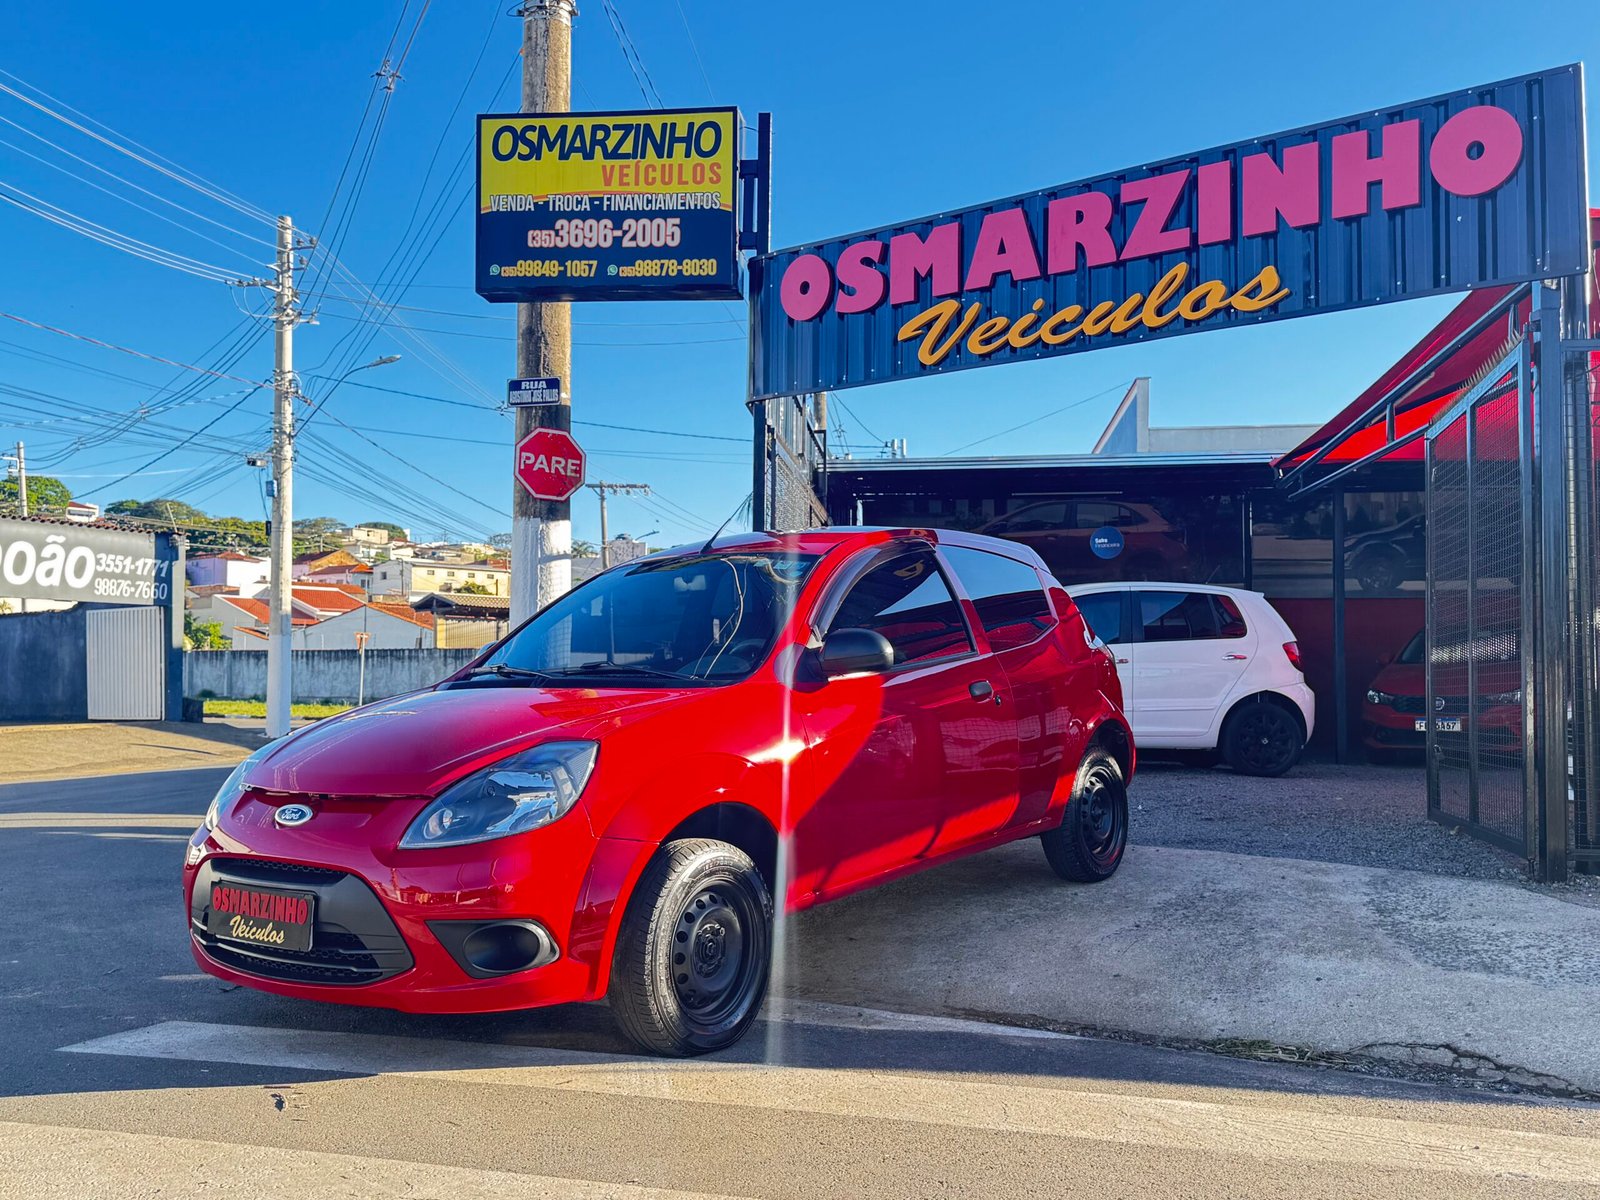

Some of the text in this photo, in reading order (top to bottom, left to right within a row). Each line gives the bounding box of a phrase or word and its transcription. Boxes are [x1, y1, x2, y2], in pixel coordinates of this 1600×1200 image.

[492, 121, 722, 161] OSMARZINHO
[601, 160, 722, 187] VEÍCULOS
[489, 194, 535, 213] VENDA
[547, 194, 591, 212] TROCA
[602, 192, 721, 212] FINANCIAMENTOS
[780, 105, 1523, 322] OSMARZINHO
[521, 381, 547, 390] RUA
[520, 452, 580, 477] PARE
[0, 535, 96, 588] oão
[281, 808, 302, 820] Ford
[213, 887, 308, 924] OSMARZINHO
